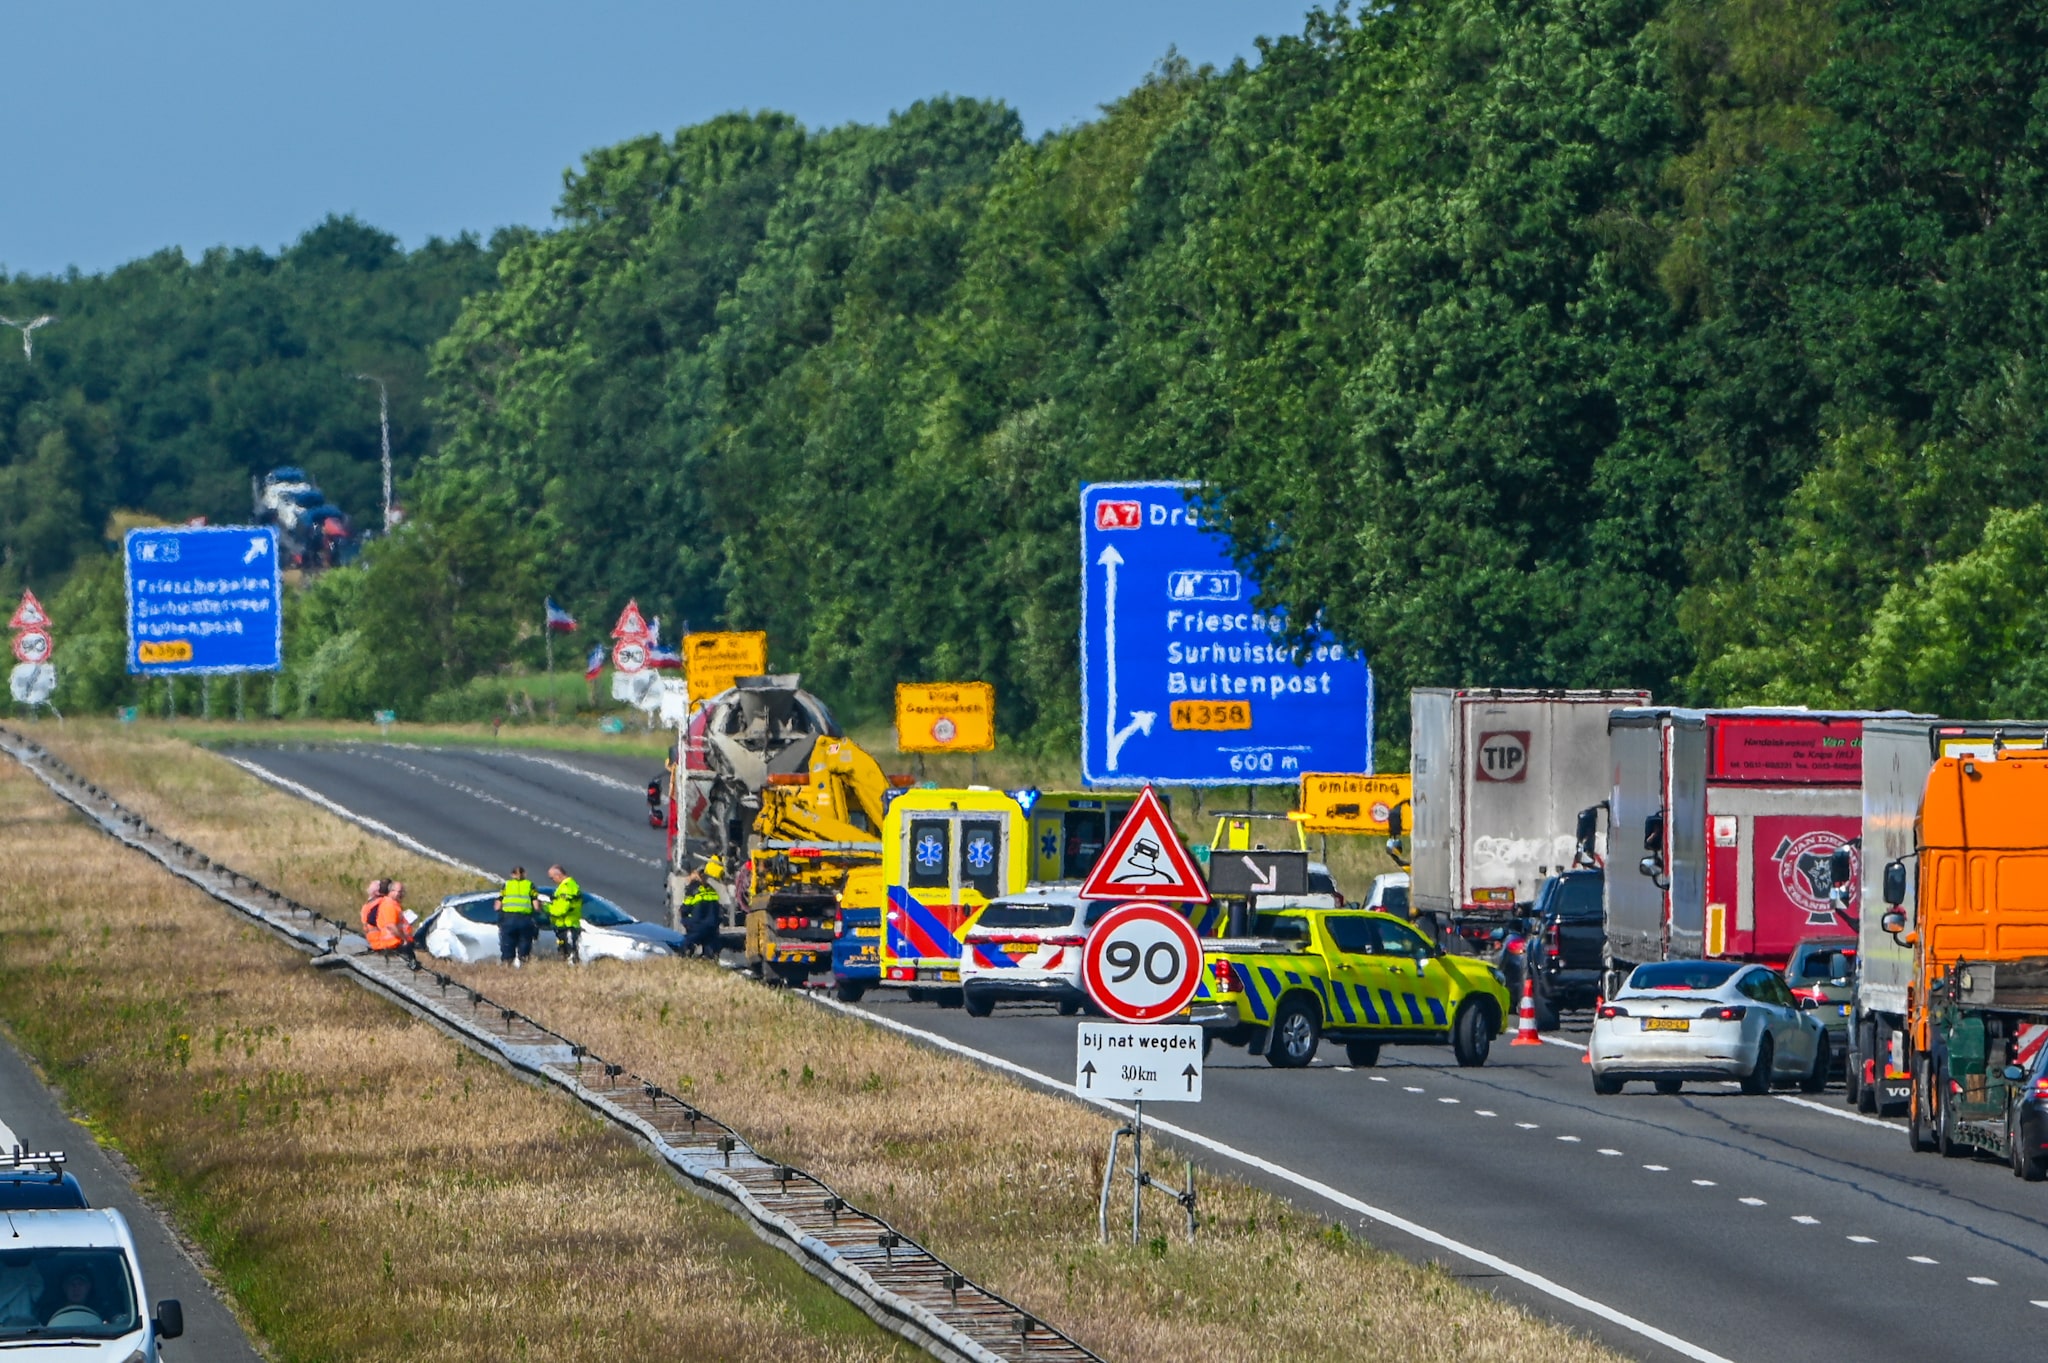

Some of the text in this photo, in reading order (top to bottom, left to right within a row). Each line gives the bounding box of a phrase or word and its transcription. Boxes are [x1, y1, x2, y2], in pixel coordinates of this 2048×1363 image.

[1101, 505, 1138, 524] A7
[1209, 577, 1230, 594] 31
[1167, 671, 1331, 700] Buitenpost
[1823, 736, 1846, 748] Van
[1230, 753, 1299, 772] 600 m
[1483, 747, 1522, 770] TIP
[1319, 781, 1400, 796] omleiding
[1790, 837, 1816, 855] VAN
[1106, 940, 1180, 986] 90
[1084, 1033, 1197, 1053] bij nat wegdek
